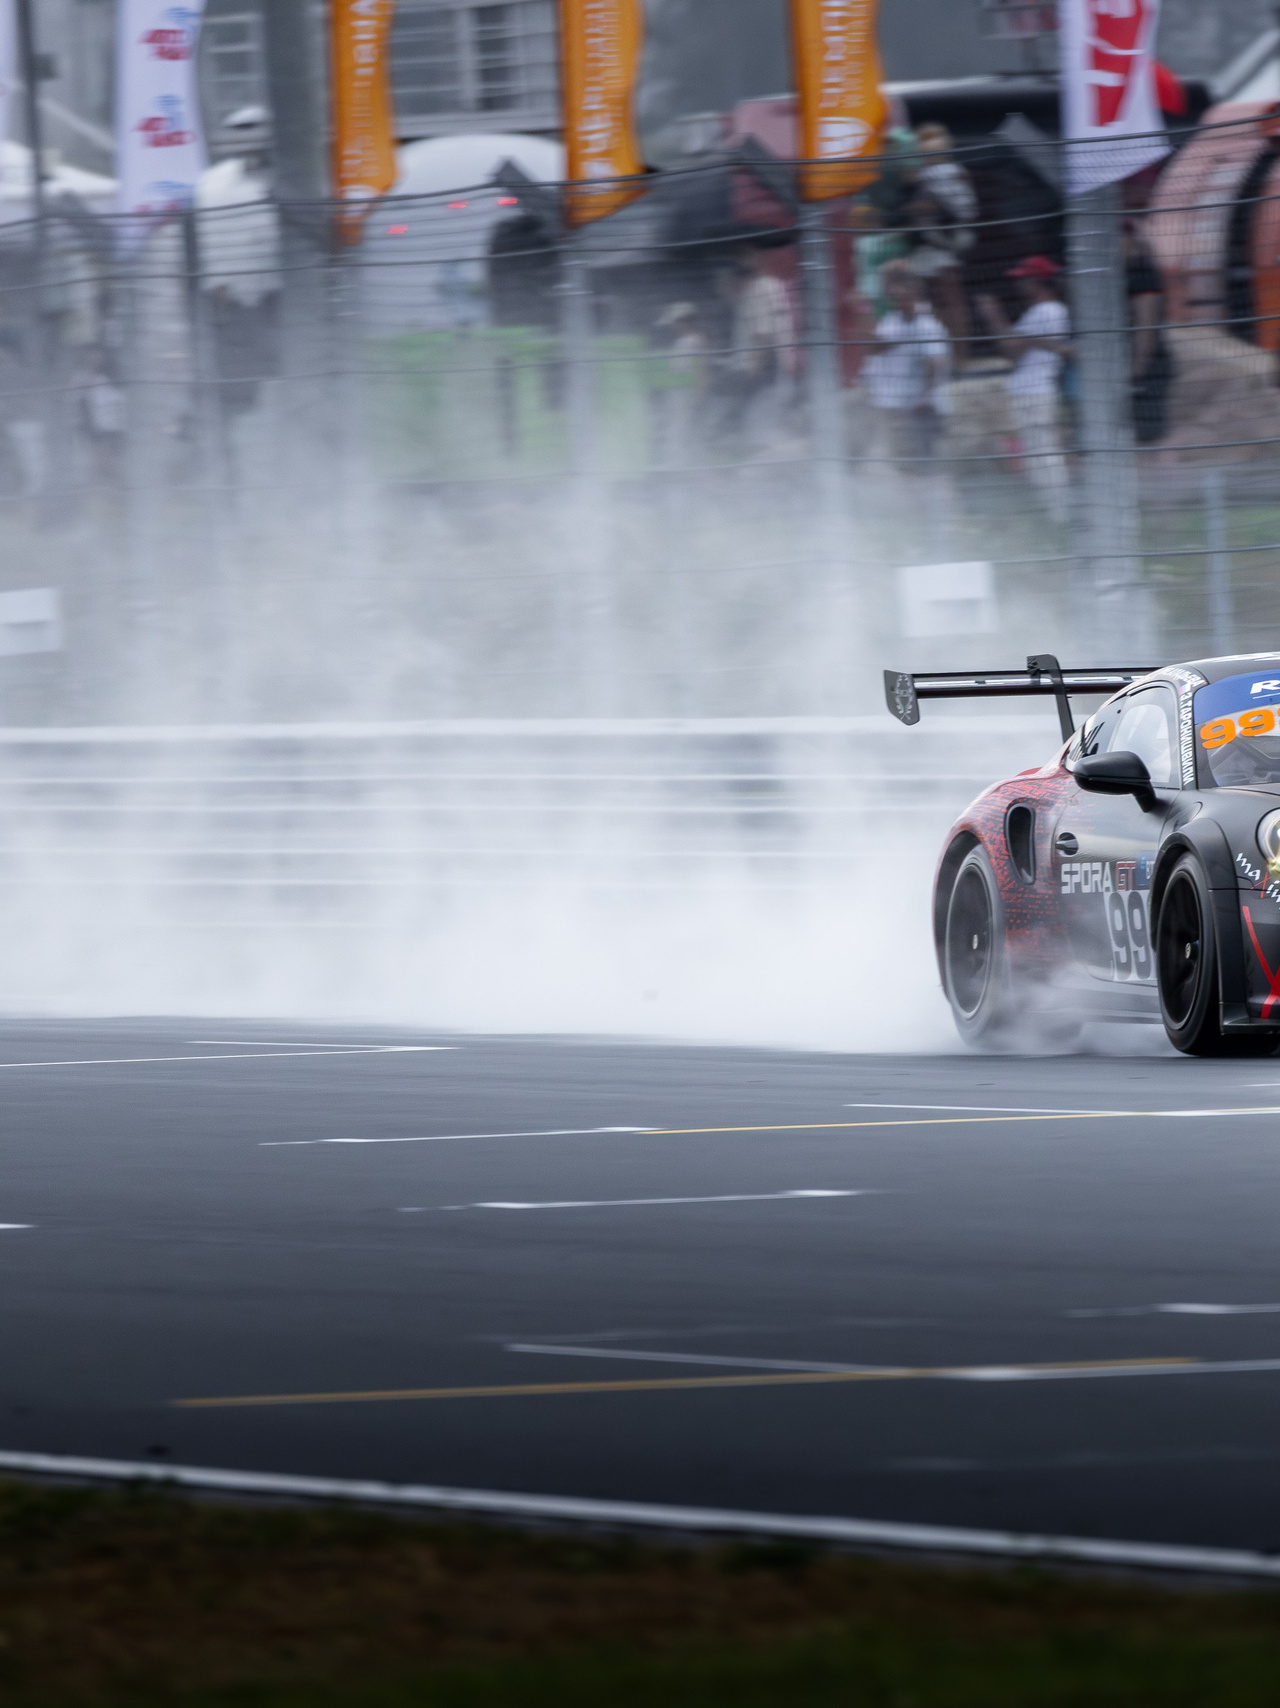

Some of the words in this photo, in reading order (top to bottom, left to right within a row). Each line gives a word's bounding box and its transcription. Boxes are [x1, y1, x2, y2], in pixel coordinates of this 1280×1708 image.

[1061, 862, 1113, 894] SPORA
[1116, 861, 1136, 891] GT
[1105, 889, 1157, 981] 99
